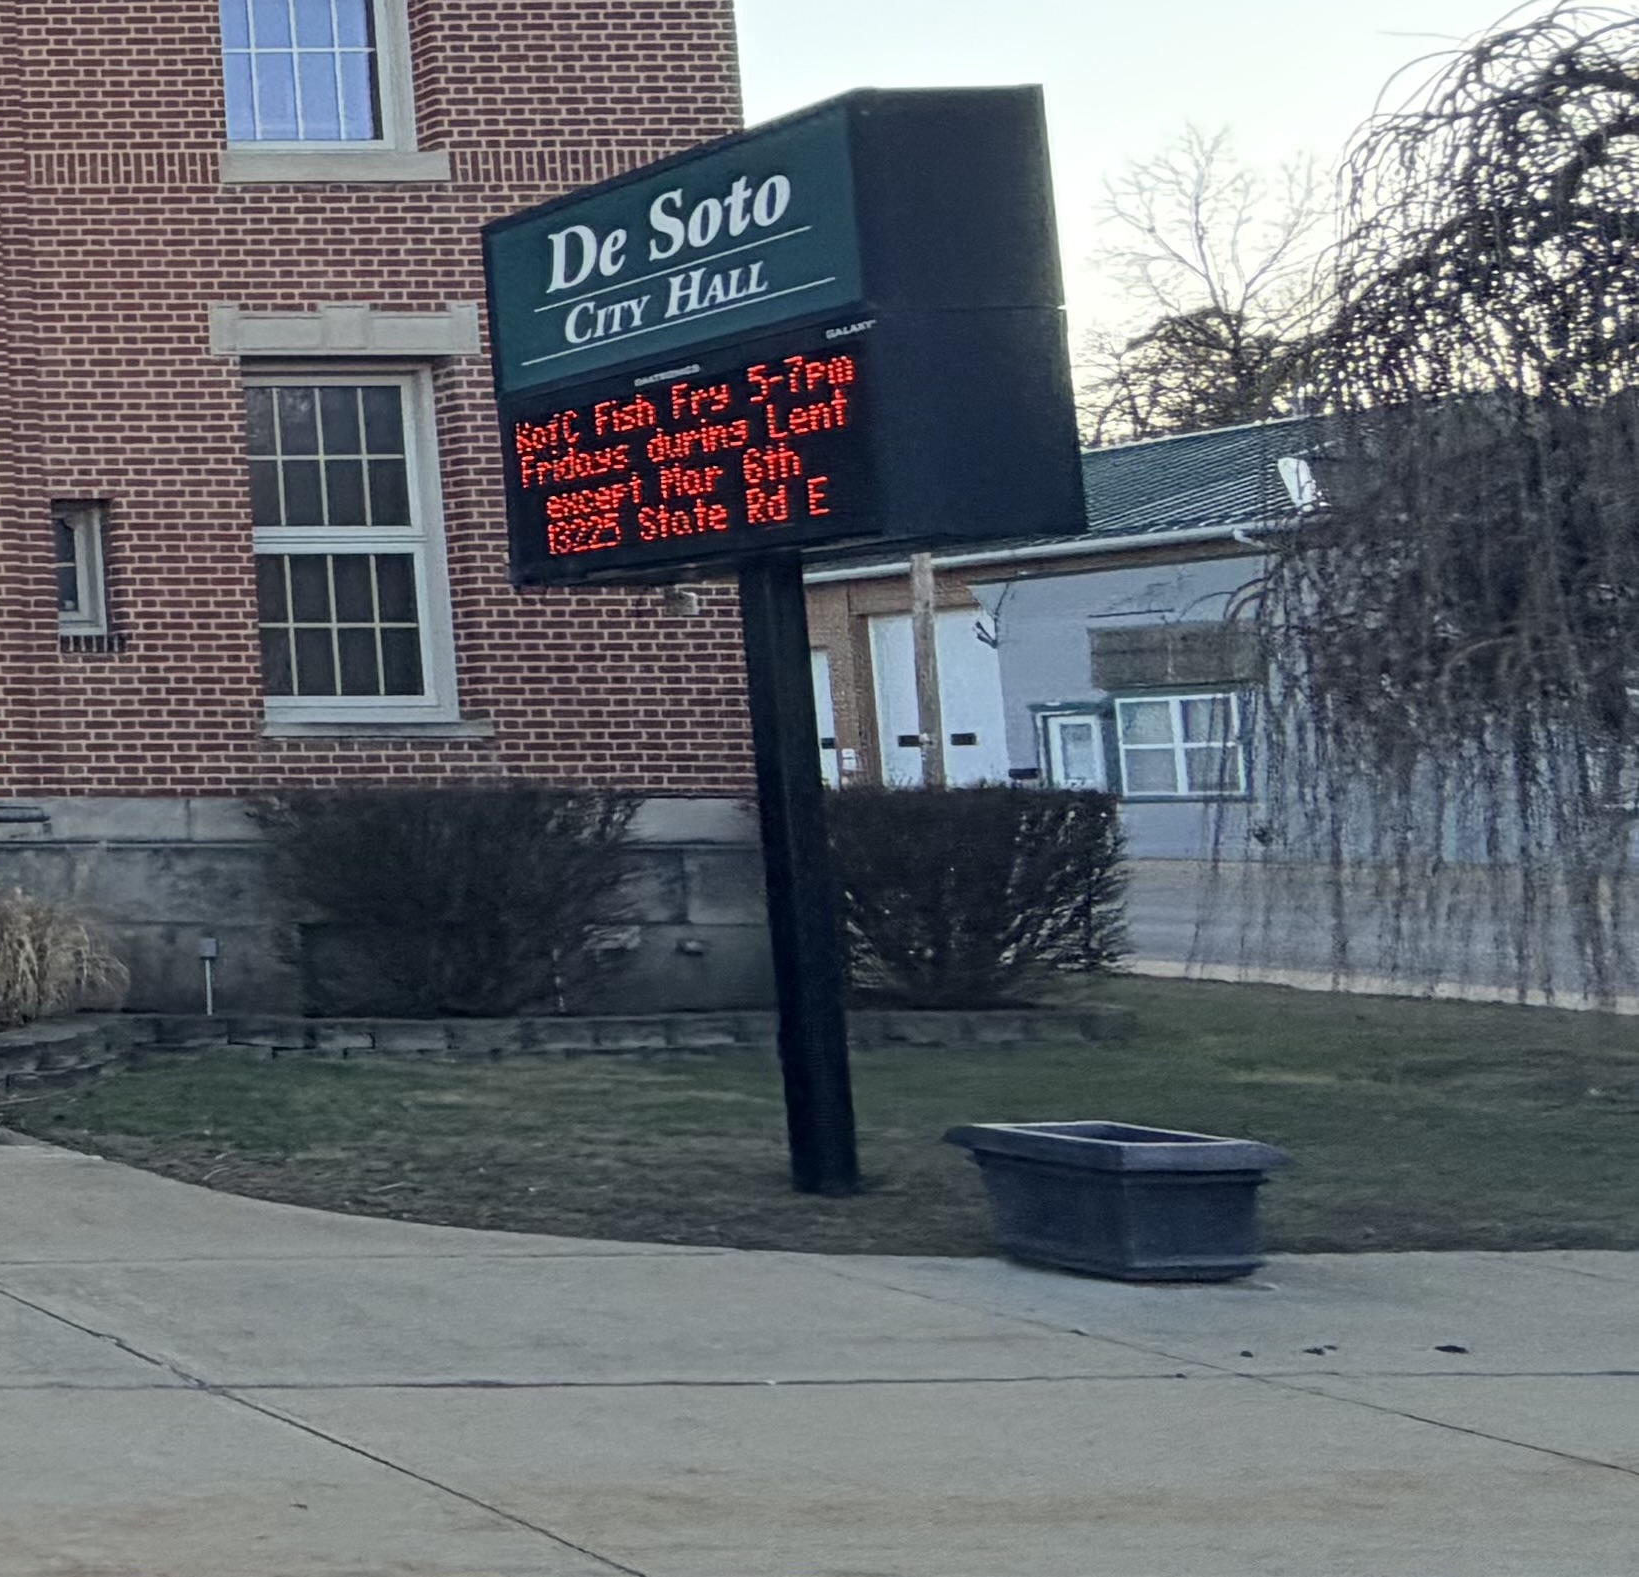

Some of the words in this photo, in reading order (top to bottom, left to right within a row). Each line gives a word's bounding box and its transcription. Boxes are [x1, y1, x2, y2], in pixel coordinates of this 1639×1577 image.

[545, 225, 627, 294] De
[648, 174, 792, 262] Soto
[564, 294, 652, 344] CITY
[664, 260, 769, 319] HALL
[516, 409, 581, 455] KofC
[594, 393, 656, 436] Fish
[671, 383, 730, 420] Fry
[746, 355, 855, 403] 5-7pm
[520, 444, 630, 489] Fridays
[646, 418, 748, 463] during
[766, 388, 848, 438] Lent
[546, 472, 643, 519] except
[659, 462, 724, 499] Mar
[742, 441, 801, 484] 6th
[637, 497, 729, 541] State
[745, 484, 789, 524] Rd
[807, 476, 831, 516] E
